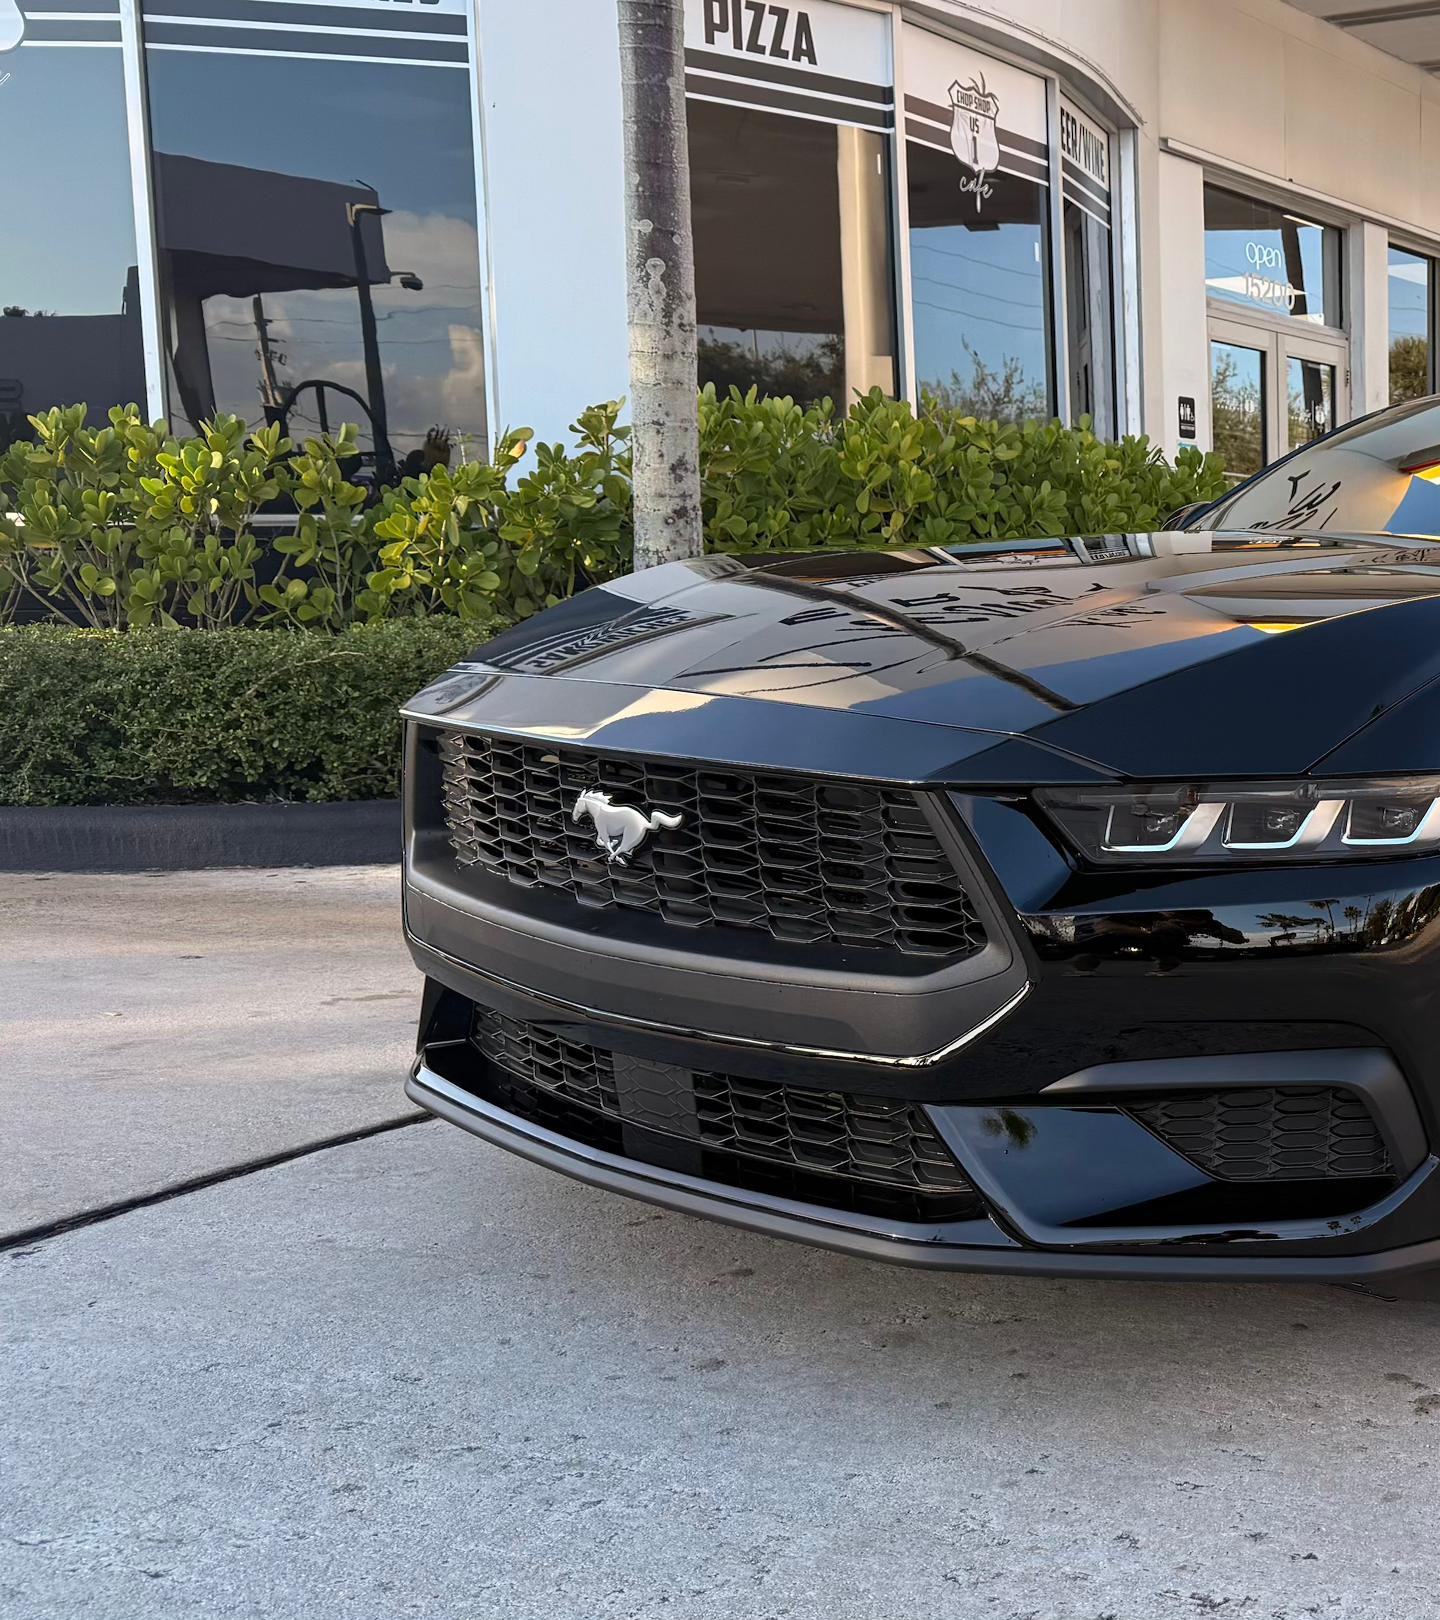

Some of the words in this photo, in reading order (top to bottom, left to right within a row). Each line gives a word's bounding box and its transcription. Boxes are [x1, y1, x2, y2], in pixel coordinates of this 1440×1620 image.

[704, 0, 818, 66] PIZZA
[956, 89, 974, 107] CHOP
[974, 96, 992, 114] SHOP
[969, 116, 980, 134] US
[972, 136, 979, 164] 1
[1060, 106, 1105, 183] EER/WINE
[1246, 242, 1282, 270] open
